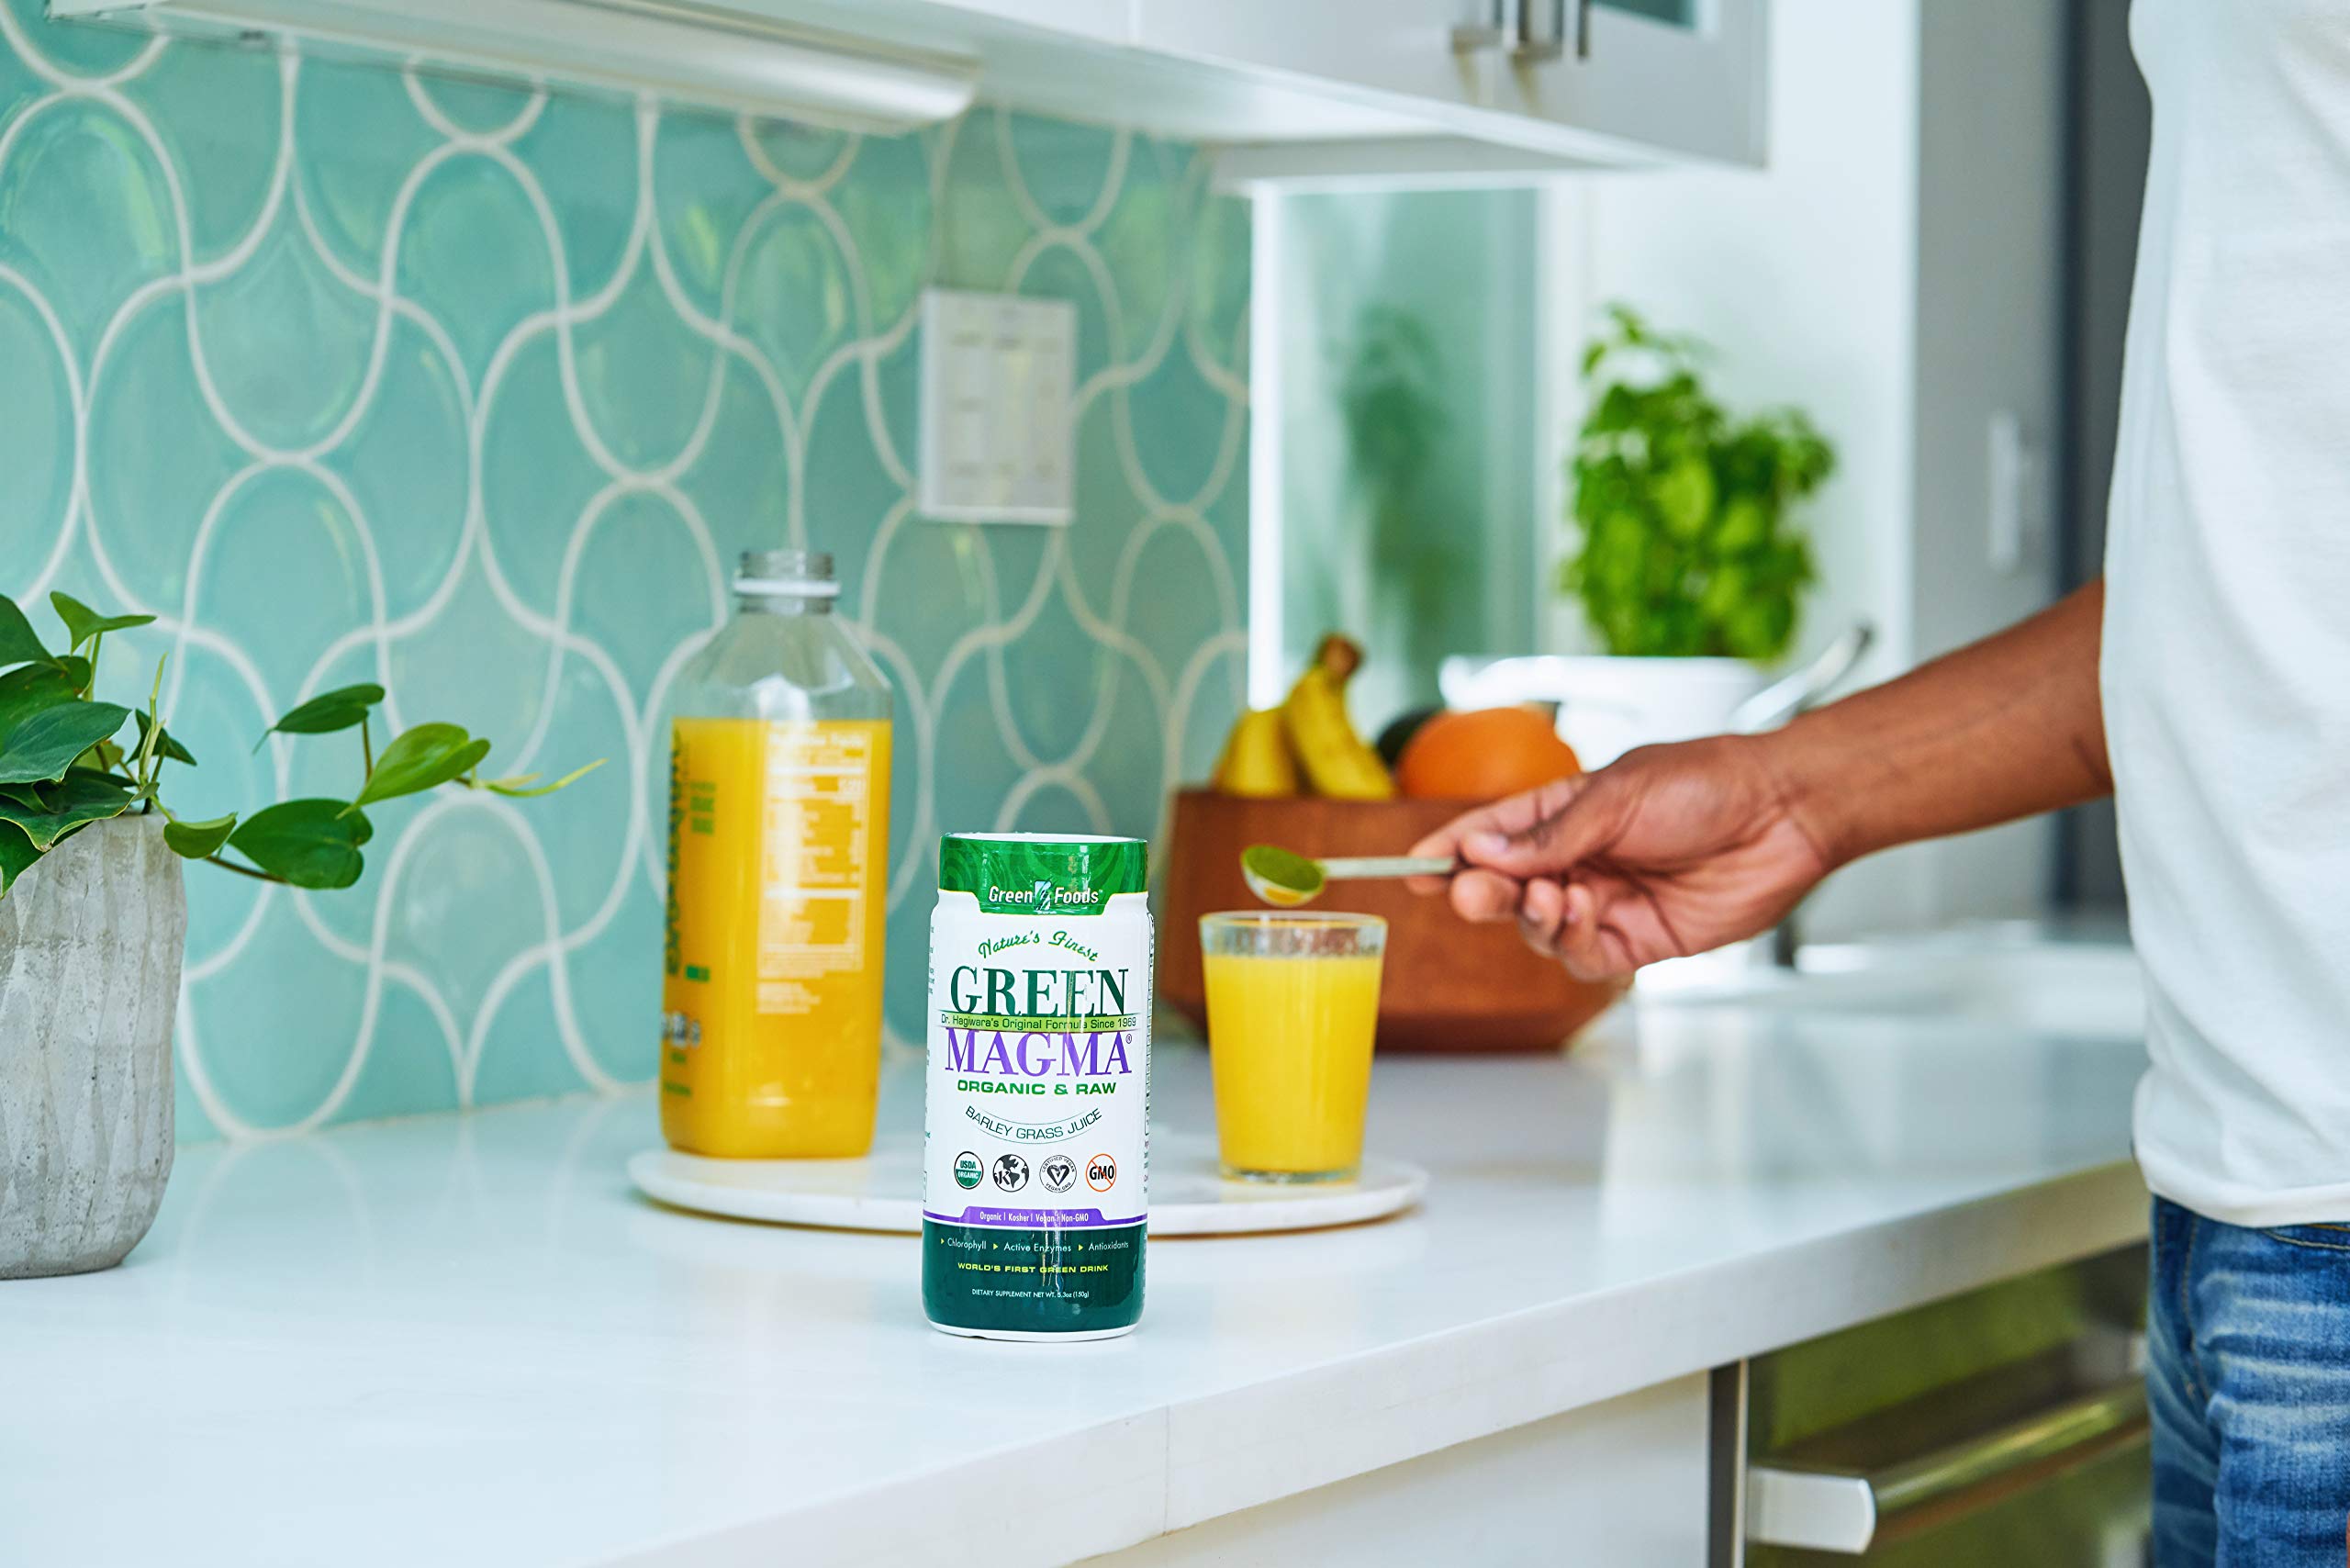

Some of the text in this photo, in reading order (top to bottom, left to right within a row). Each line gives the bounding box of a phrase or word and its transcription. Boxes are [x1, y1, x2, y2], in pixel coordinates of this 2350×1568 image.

[989, 886, 1099, 903] Green Foods
[979, 930, 1098, 961] Nature's Finest
[950, 966, 1129, 1017] GREEN
[941, 1015, 1136, 1030] Dr. Hagiwara's Original Formula Since 1969
[957, 1080, 1116, 1095] ORGANIC & RAW
[966, 1105, 1102, 1139] BARLEY GRASS JUICE
[960, 1160, 977, 1170] USDA
[957, 1170, 979, 1180] ORGANIC
[1089, 1165, 1114, 1181] GMO
[979, 1211, 1089, 1223] Organic Kosher Vegan Non-GMO
[947, 1238, 1129, 1254] Chlorophyll Active Enzymes Antioxidants
[957, 1262, 1001, 1271] WORLD'S
[1080, 1264, 1109, 1272] DRINK
